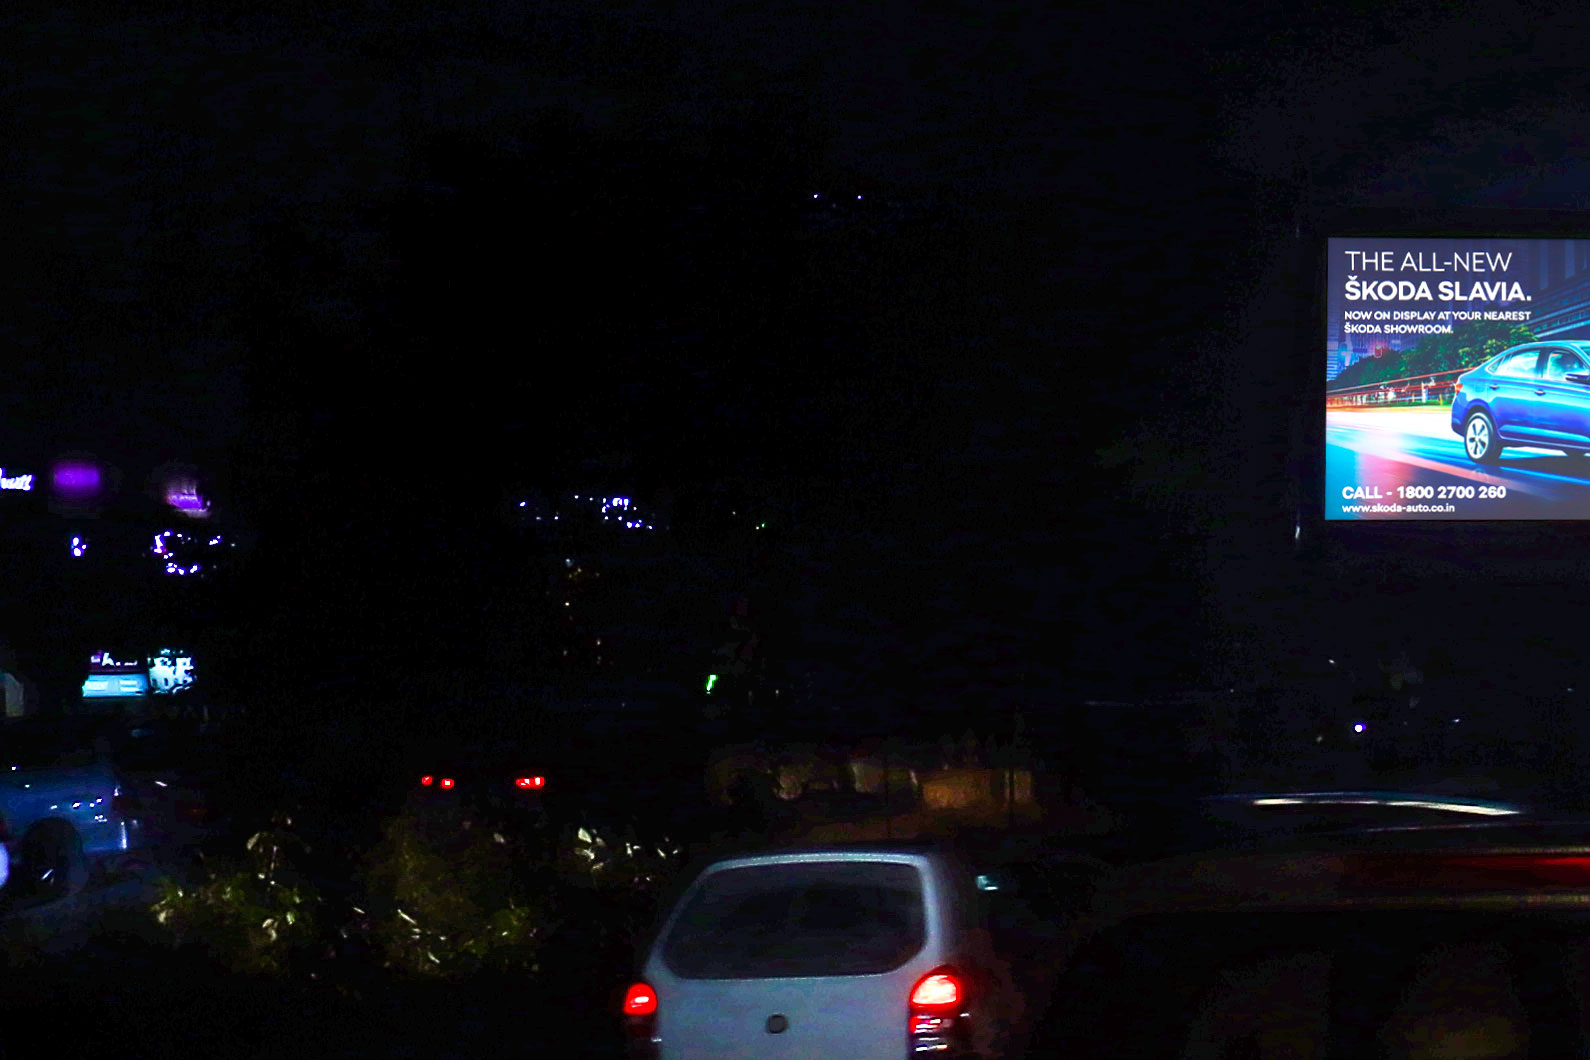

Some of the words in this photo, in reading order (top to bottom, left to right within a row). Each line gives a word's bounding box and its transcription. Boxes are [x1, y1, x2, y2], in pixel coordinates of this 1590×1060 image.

[1345, 251, 1394, 271] THE
[1400, 252, 1512, 272] ALL-NEW
[1344, 275, 1433, 301] ŠKODA
[1438, 281, 1532, 301] SLAVIA.
[1344, 311, 1372, 321] NOW
[1374, 311, 1391, 321] ON
[1393, 311, 1436, 321] DISPLAY
[1438, 311, 1450, 321] AT
[1452, 311, 1481, 321] YOUR
[1484, 311, 1532, 321] NEAREST
[1344, 322, 1381, 334] ŠKODA
[1384, 324, 1454, 334] SHOWROOM.
[1342, 486, 1382, 499] CALL
[1397, 486, 1434, 499] 1800
[1437, 486, 1475, 499] 2700
[1478, 486, 1507, 499] 260
[1342, 503, 1455, 513] www.skoda-auto.co.in
